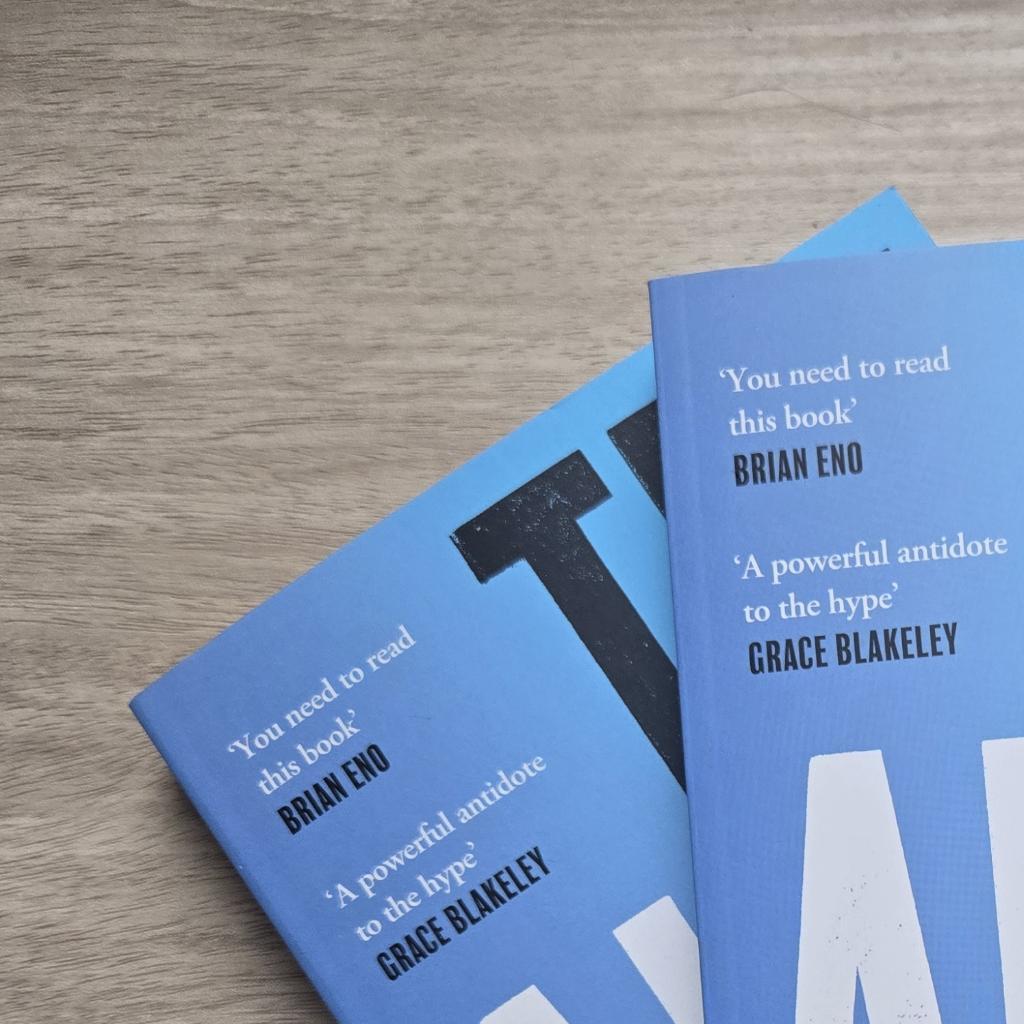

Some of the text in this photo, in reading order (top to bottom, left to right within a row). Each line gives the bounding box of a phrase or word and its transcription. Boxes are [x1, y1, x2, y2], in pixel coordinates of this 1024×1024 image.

[719, 345, 951, 393] ‘You need to read
[729, 398, 857, 436] this book’
[733, 441, 864, 487] BRIAN ENO
[734, 532, 1008, 585] ‘A powerful antidote
[744, 582, 898, 623] to the hype’
[749, 622, 957, 675] GRACE BLAKELEY
[227, 624, 417, 760] ‘You need to read
[257, 708, 361, 795] this book’
[277, 743, 391, 835] BRIAN ENO
[325, 755, 548, 909] ‘A powerful antidote
[356, 841, 478, 942] to the hype’
[376, 846, 551, 981] GRACE BLAKELEY
